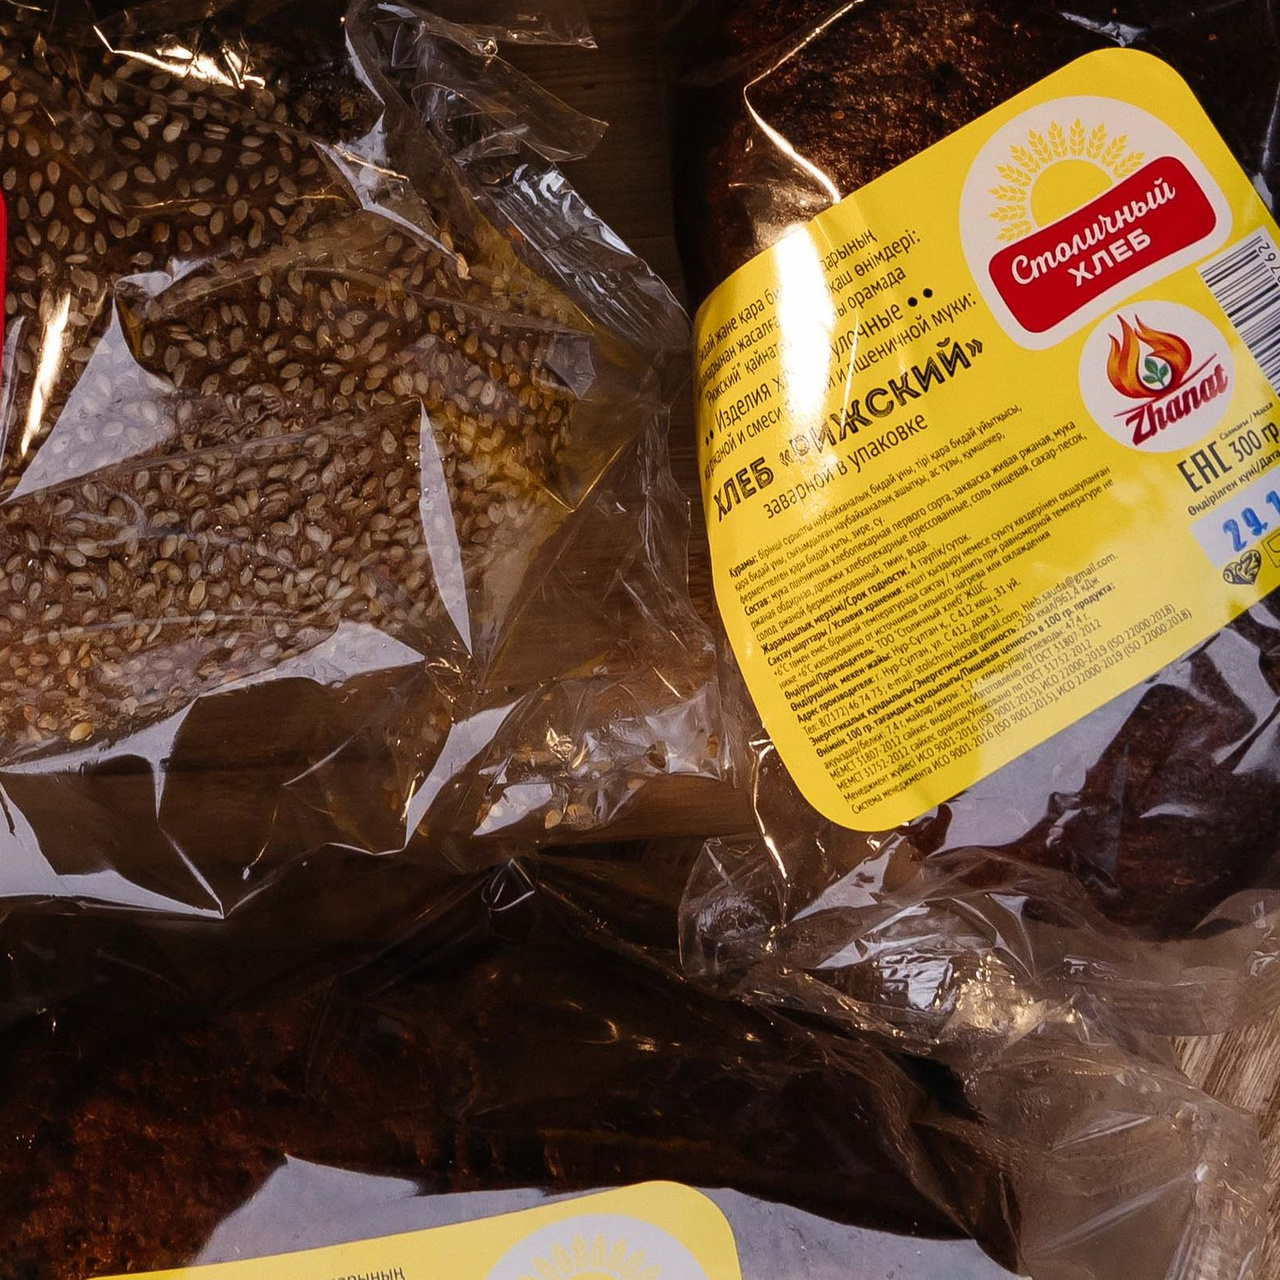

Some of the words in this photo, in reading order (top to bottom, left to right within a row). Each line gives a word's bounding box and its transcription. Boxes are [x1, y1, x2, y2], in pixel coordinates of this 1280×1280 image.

[852, 227, 922, 278] өнімдері:
[1010, 176, 1176, 285] Столичный
[1066, 227, 1151, 287] ХЛЕБ
[929, 291, 978, 328] муки:
[1124, 363, 1228, 446] Zhanat
[834, 459, 849, 477] в
[845, 413, 929, 475] упаковке
[1226, 428, 1263, 464] 300
[712, 454, 775, 524] ХЛЕБ
